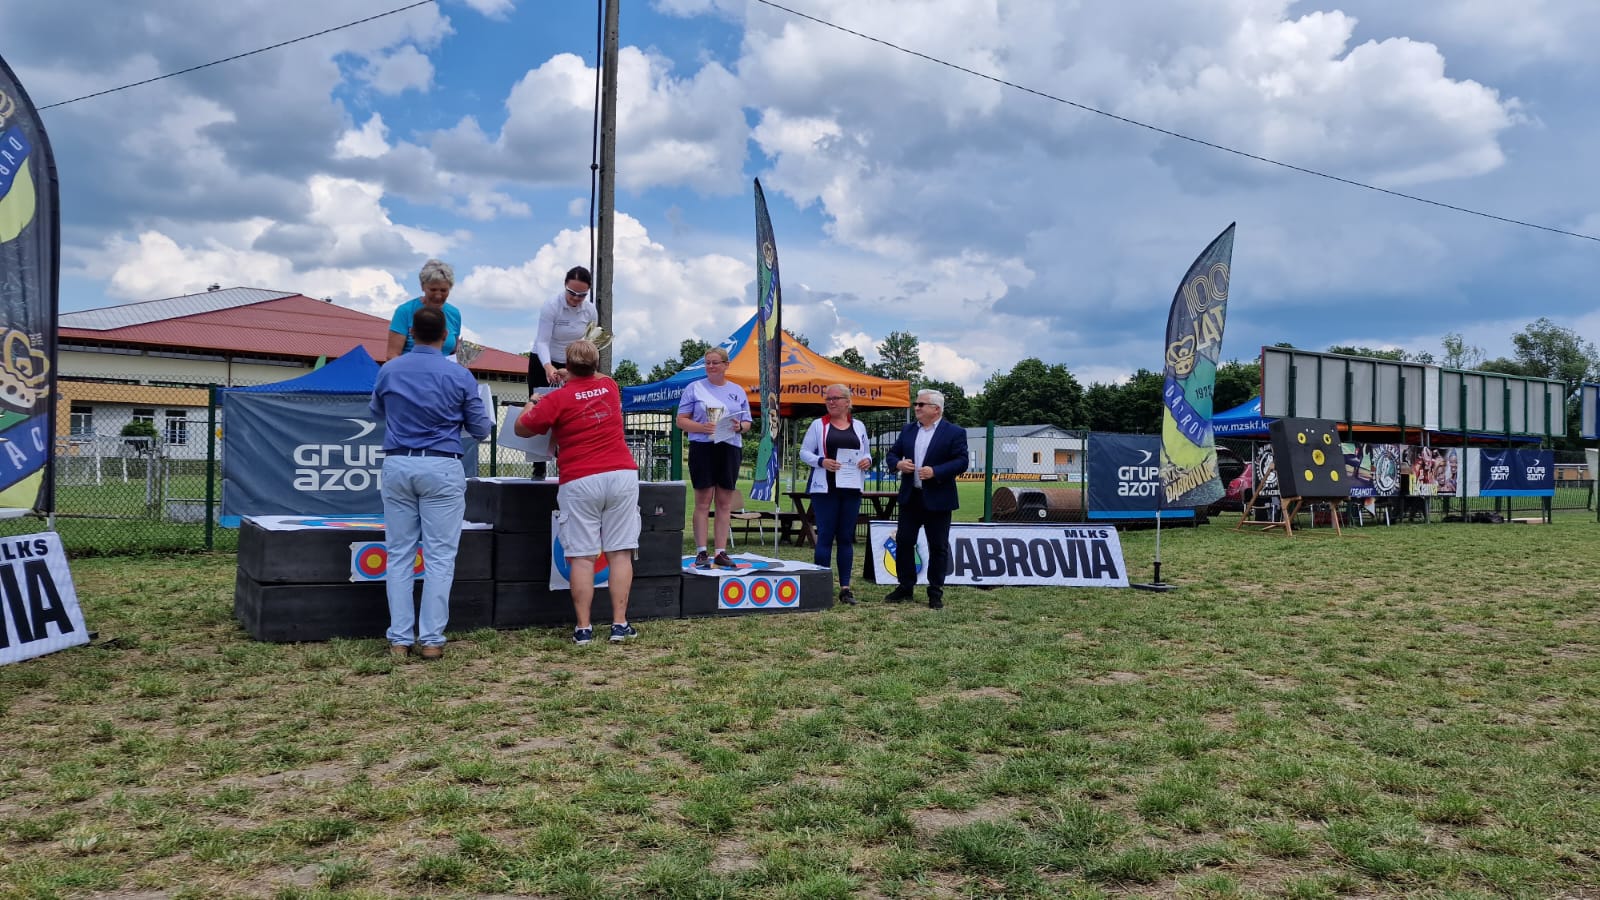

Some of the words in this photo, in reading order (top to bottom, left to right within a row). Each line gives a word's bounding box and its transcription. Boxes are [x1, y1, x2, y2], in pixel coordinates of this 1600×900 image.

[575, 387, 608, 401] SĘDZIA
[1064, 529, 1109, 539] MLKS
[0, 538, 49, 561] LKS
[949, 537, 1119, 582] ĄBROVIA
